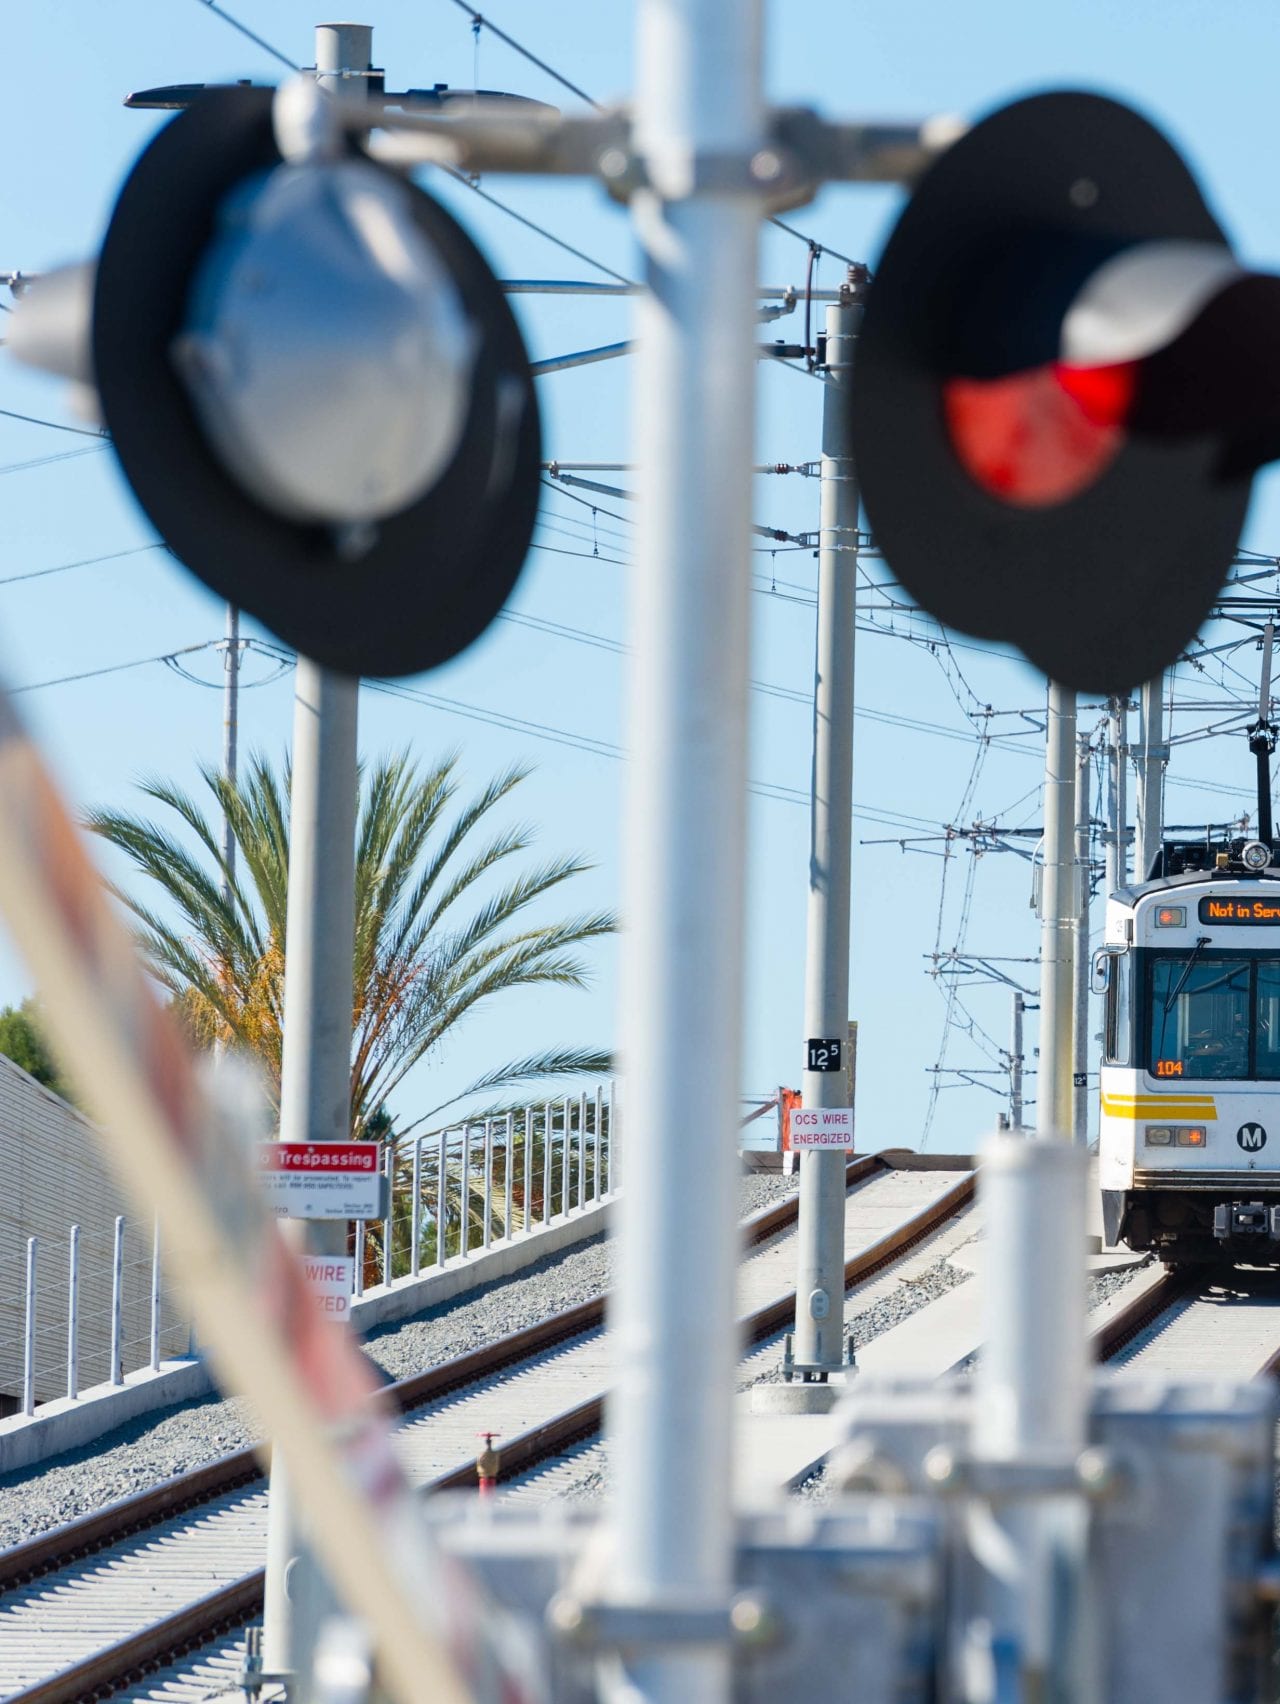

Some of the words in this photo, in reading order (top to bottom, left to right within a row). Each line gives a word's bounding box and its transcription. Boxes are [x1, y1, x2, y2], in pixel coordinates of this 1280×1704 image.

[1209, 902, 1233, 917] Not
[1237, 904, 1250, 917] in
[1157, 1061, 1183, 1075] 104
[795, 1114, 818, 1125] OCS
[822, 1114, 849, 1125] WIRE
[793, 1133, 851, 1145] ENERGIZED
[1242, 1127, 1262, 1147] M
[278, 1150, 373, 1168] Trespassing
[305, 1265, 346, 1281] WIRE
